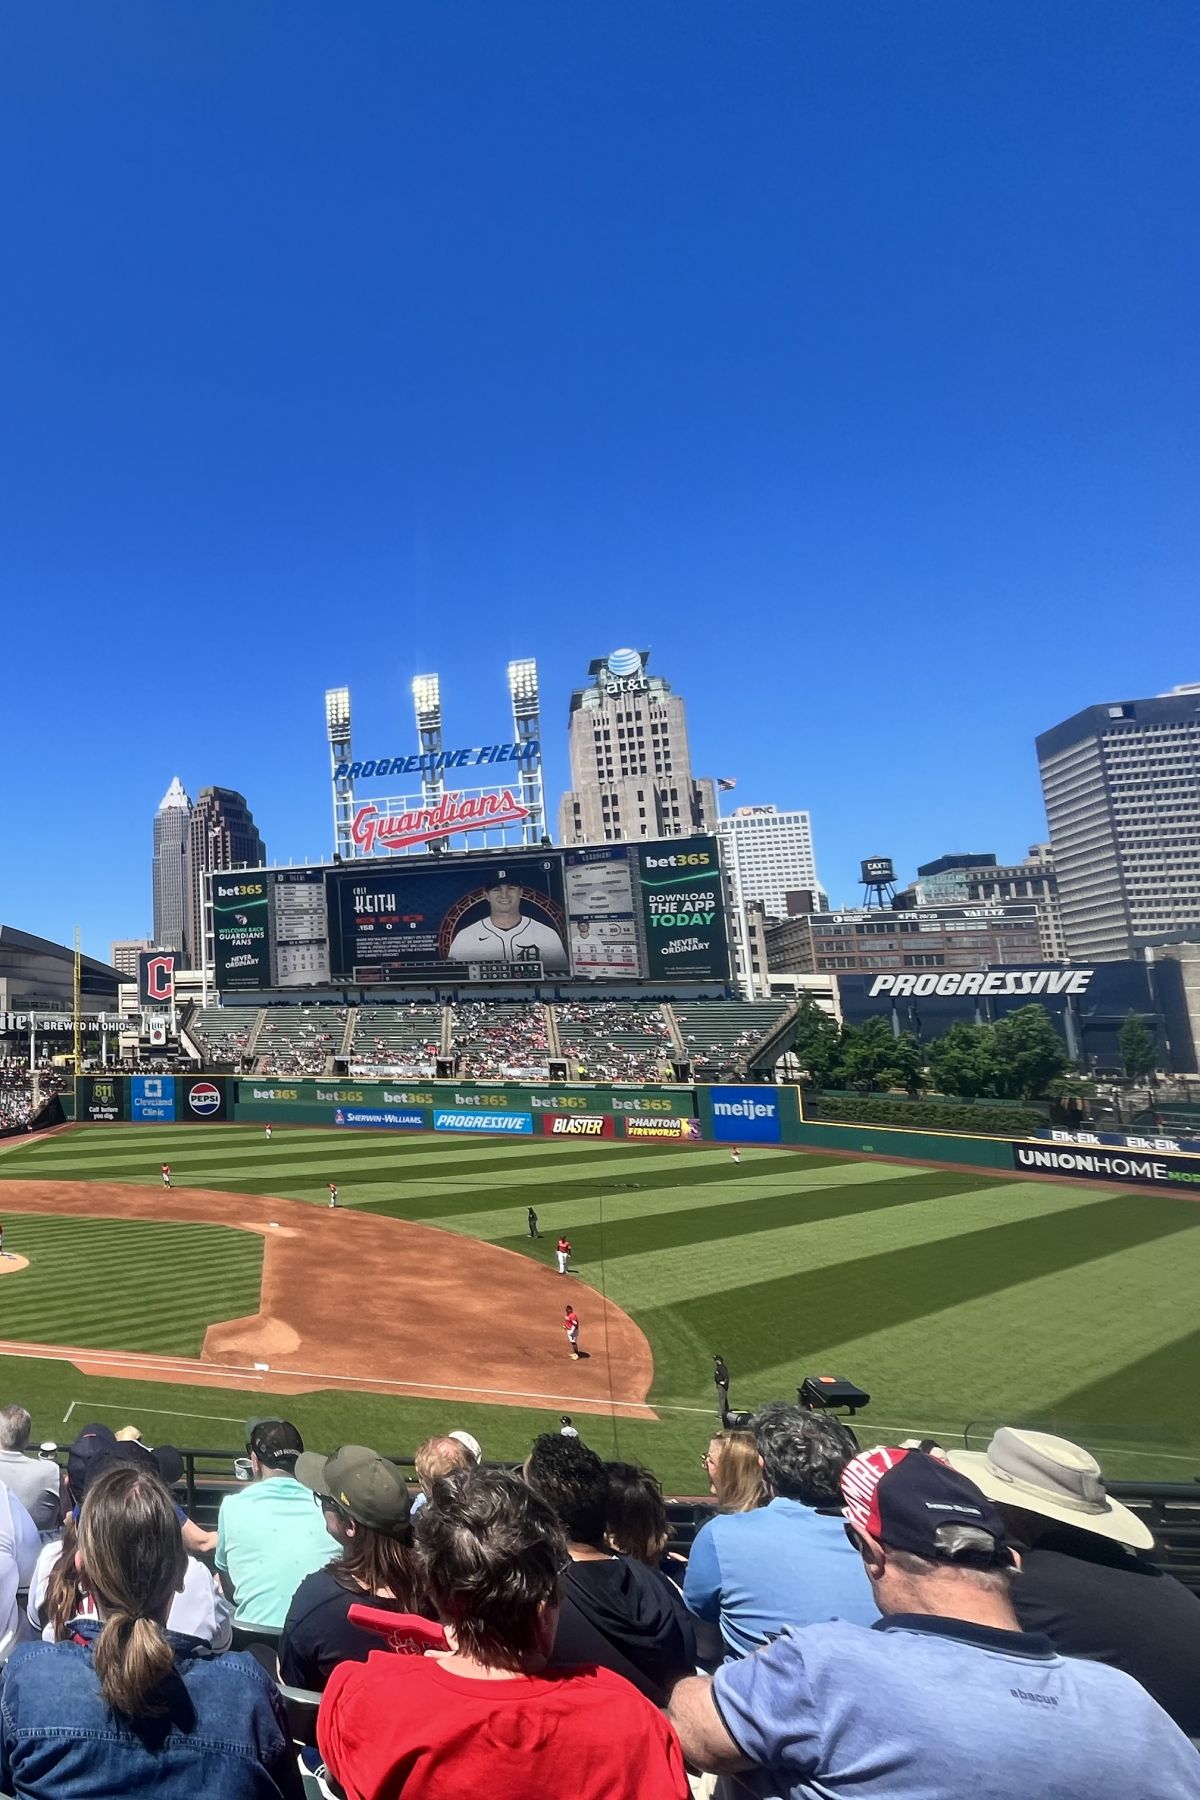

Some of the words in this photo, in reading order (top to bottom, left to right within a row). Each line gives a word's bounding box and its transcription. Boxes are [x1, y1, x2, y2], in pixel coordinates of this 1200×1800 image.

[606, 676, 648, 694] at&t
[333, 752, 471, 780] PROGRESSIVE
[475, 741, 541, 765] FIELD
[351, 789, 532, 853] Guardians
[645, 853, 710, 868] bet365
[218, 884, 262, 897] bet365
[353, 887, 367, 895] COLT
[354, 893, 396, 914] KEITH
[649, 892, 715, 903] DOWNLOAD
[649, 903, 679, 914] THE
[682, 901, 716, 913] APP
[650, 912, 716, 928] TODAY
[219, 931, 265, 940] GUARDIANS
[661, 942, 710, 955] ORDINARY
[668, 937, 699, 948] NEVER
[225, 958, 260, 969] ORDINARY
[231, 954, 252, 962] NEVER
[147, 956, 175, 1000] C
[868, 969, 1095, 998] PROGRESSIVE
[88, 1022, 100, 1031] IN
[101, 1021, 126, 1031] OHIO
[94, 1084, 114, 1098] 811
[253, 1089, 298, 1100] bet365
[316, 1090, 364, 1101] bet365
[383, 1091, 434, 1104] bet365
[134, 1097, 173, 1106] Cleveland
[190, 1095, 219, 1103] PEPSI
[455, 1094, 508, 1107] bet365
[531, 1095, 588, 1109] bet365
[611, 1096, 673, 1111] bet365
[142, 1108, 165, 1117] Clinic
[713, 1099, 775, 1120] meijer
[436, 1113, 526, 1131] PROGRESSIVE
[552, 1118, 604, 1135] BLASTER
[628, 1117, 681, 1129] PHANTOM
[628, 1128, 681, 1138] FIREWORKS
[841, 1446, 894, 1530] RAMIREZ
[1009, 1688, 1058, 1706] abacus
